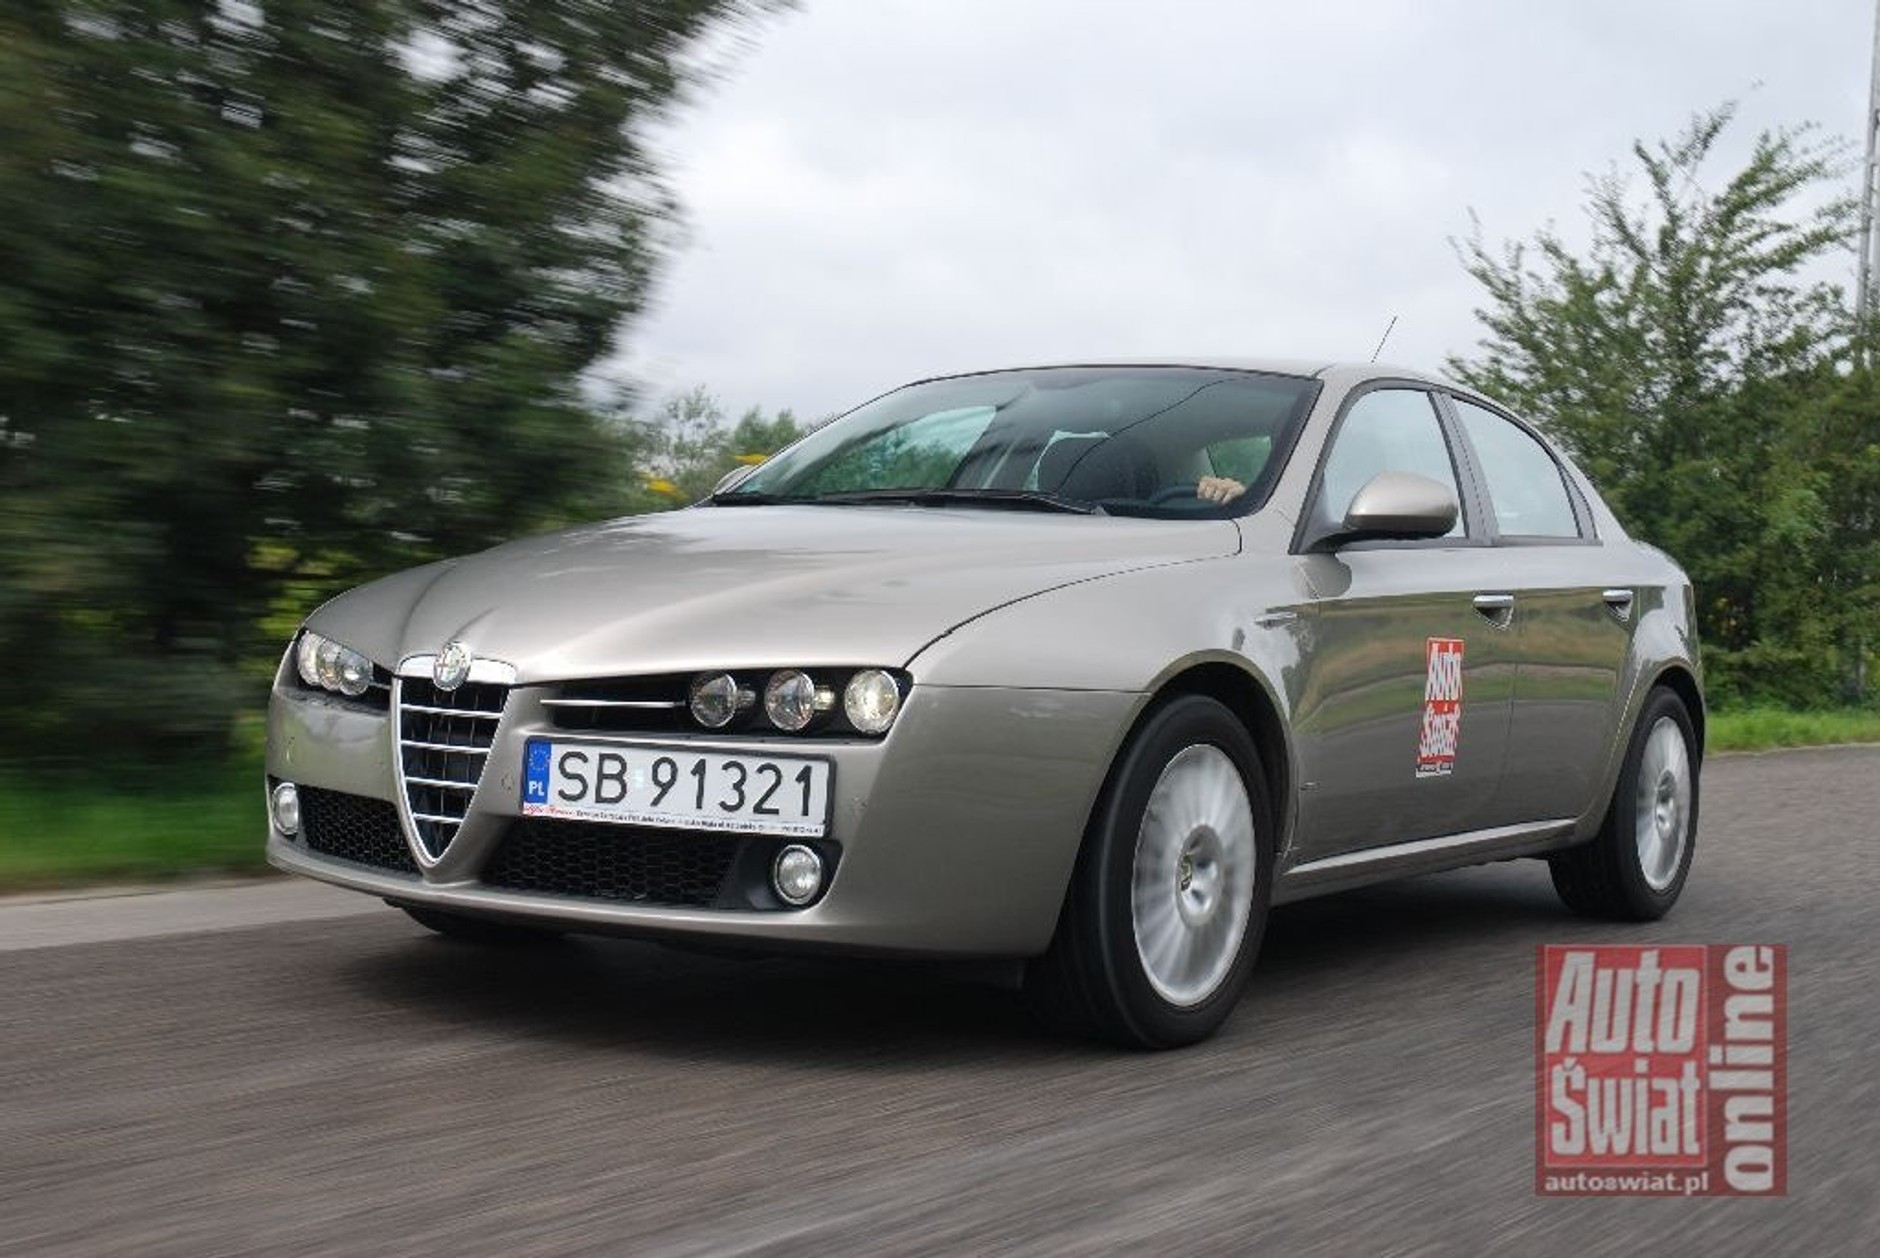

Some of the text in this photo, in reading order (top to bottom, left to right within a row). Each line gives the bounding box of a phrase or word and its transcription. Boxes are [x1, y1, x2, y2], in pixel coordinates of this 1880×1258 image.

[528, 780, 545, 797] PL
[558, 751, 813, 817] SB 91321
